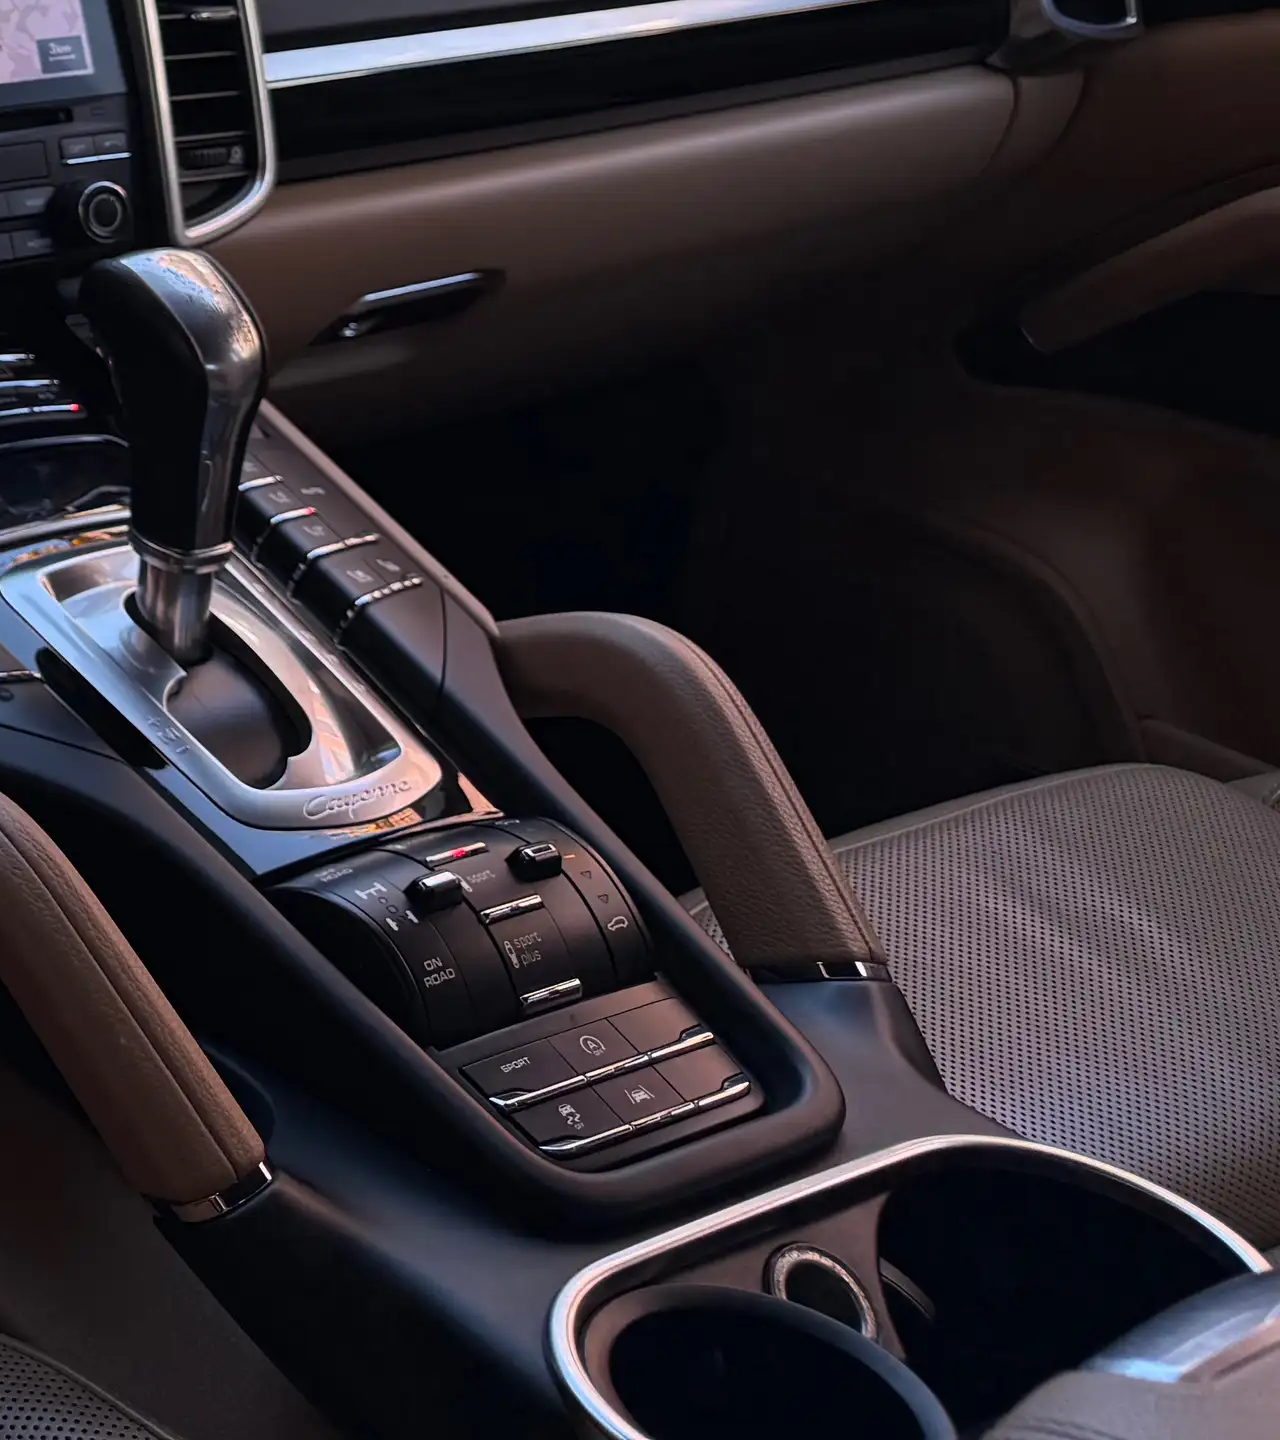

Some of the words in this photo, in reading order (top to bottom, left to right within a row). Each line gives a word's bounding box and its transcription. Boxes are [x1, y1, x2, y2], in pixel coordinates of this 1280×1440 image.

[302, 780, 412, 821] Cayenne
[466, 869, 496, 885] sport
[513, 932, 542, 950] sport
[423, 956, 442, 971] ON
[520, 949, 542, 966] plus
[423, 968, 456, 988] ROAD
[500, 1056, 531, 1074] SPORT
